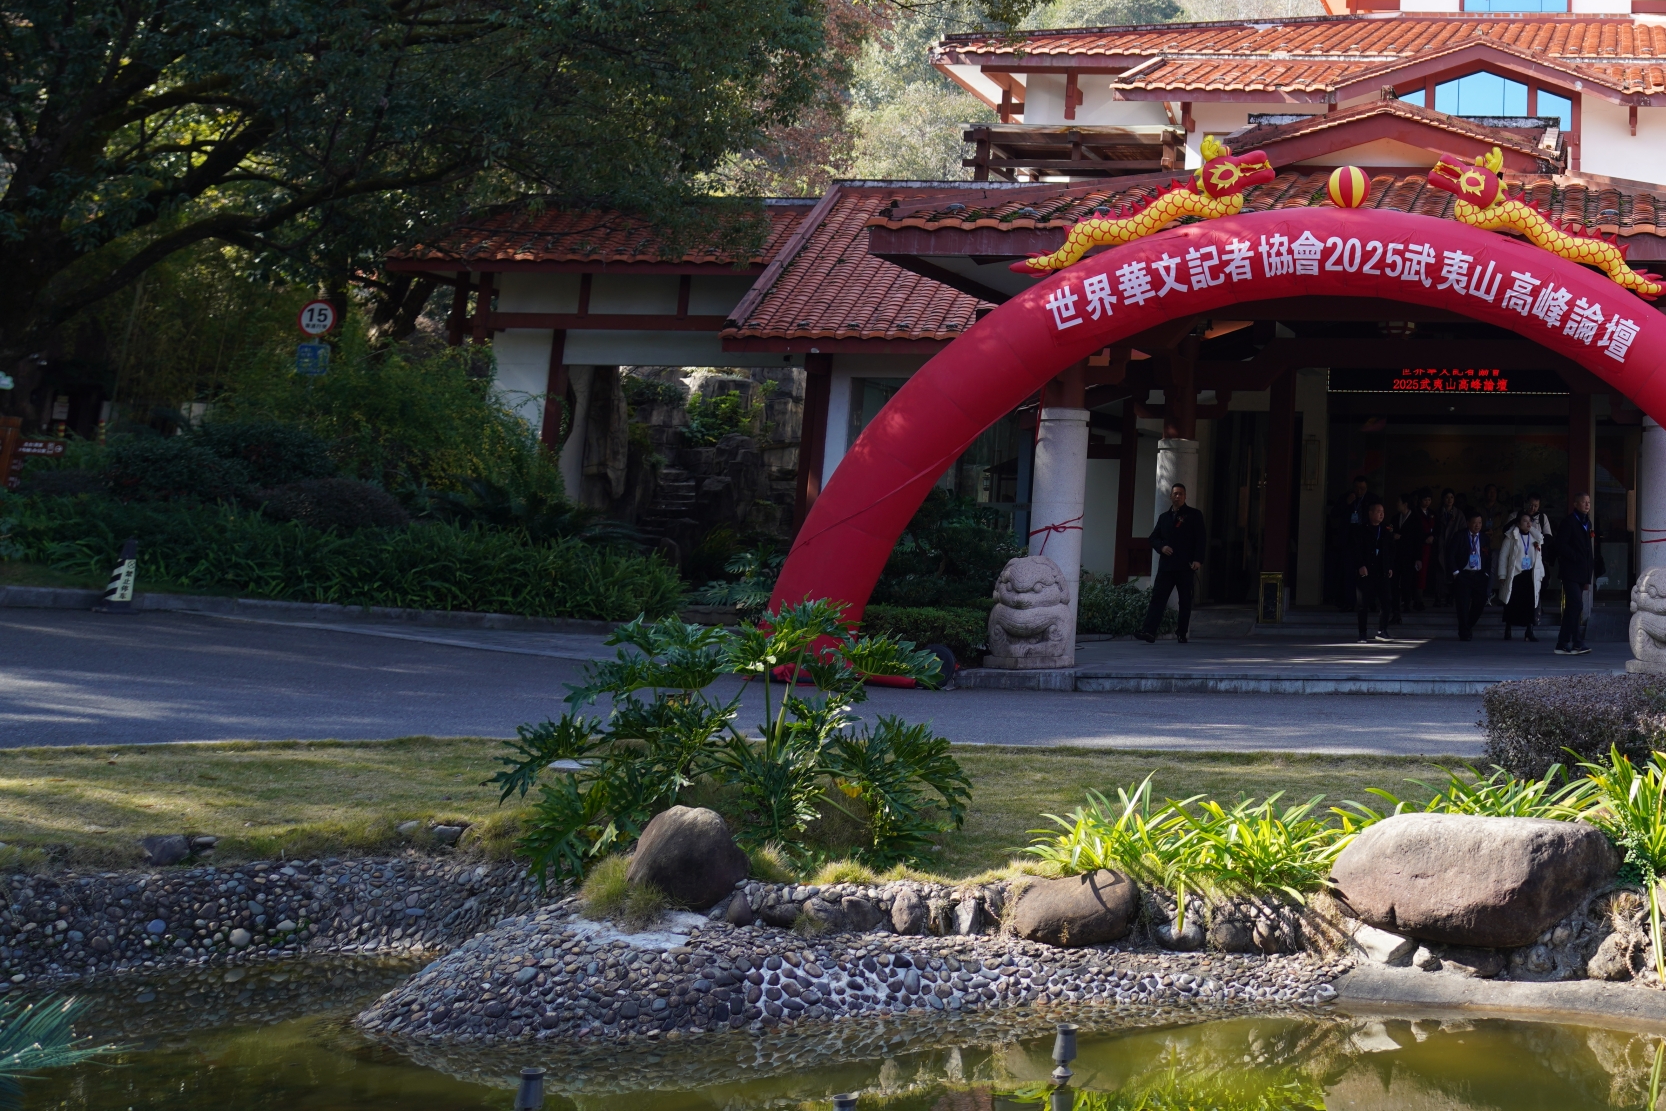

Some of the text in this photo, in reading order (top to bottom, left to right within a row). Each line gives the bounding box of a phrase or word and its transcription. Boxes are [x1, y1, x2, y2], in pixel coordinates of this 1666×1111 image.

[1046, 230, 1640, 363] 世界華文記者協會2025武夷山高峰論壇
[307, 307, 328, 323] 15
[1393, 378, 1508, 391] 2025武夷山高峰論壇
